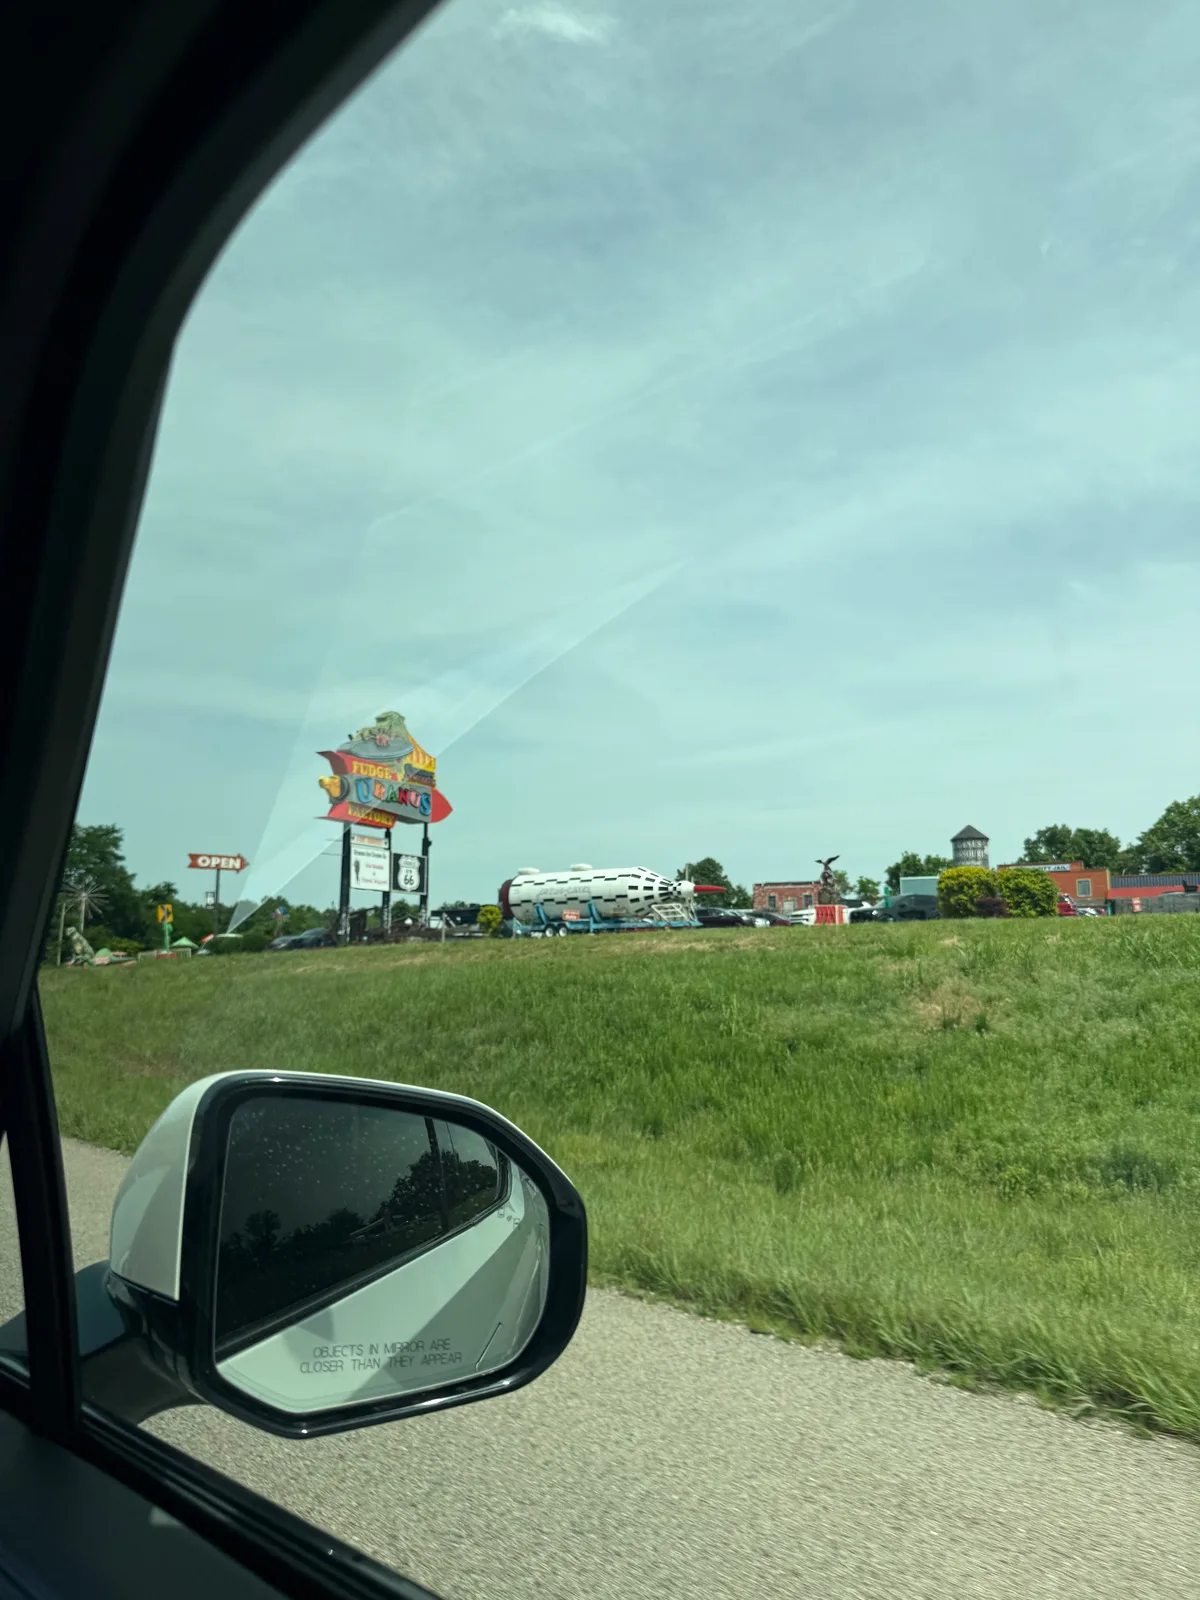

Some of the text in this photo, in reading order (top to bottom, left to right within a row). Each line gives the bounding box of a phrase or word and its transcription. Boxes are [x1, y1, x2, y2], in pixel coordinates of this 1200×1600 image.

[352, 761, 392, 778] FUDGE
[355, 778, 431, 815] URANUS
[198, 856, 241, 869] OPEN
[404, 874, 414, 886] 66
[313, 1338, 451, 1358] OBJECTS IN MIRROR ARE
[300, 1351, 463, 1374] CLOSER THAN THEY APPEAR
